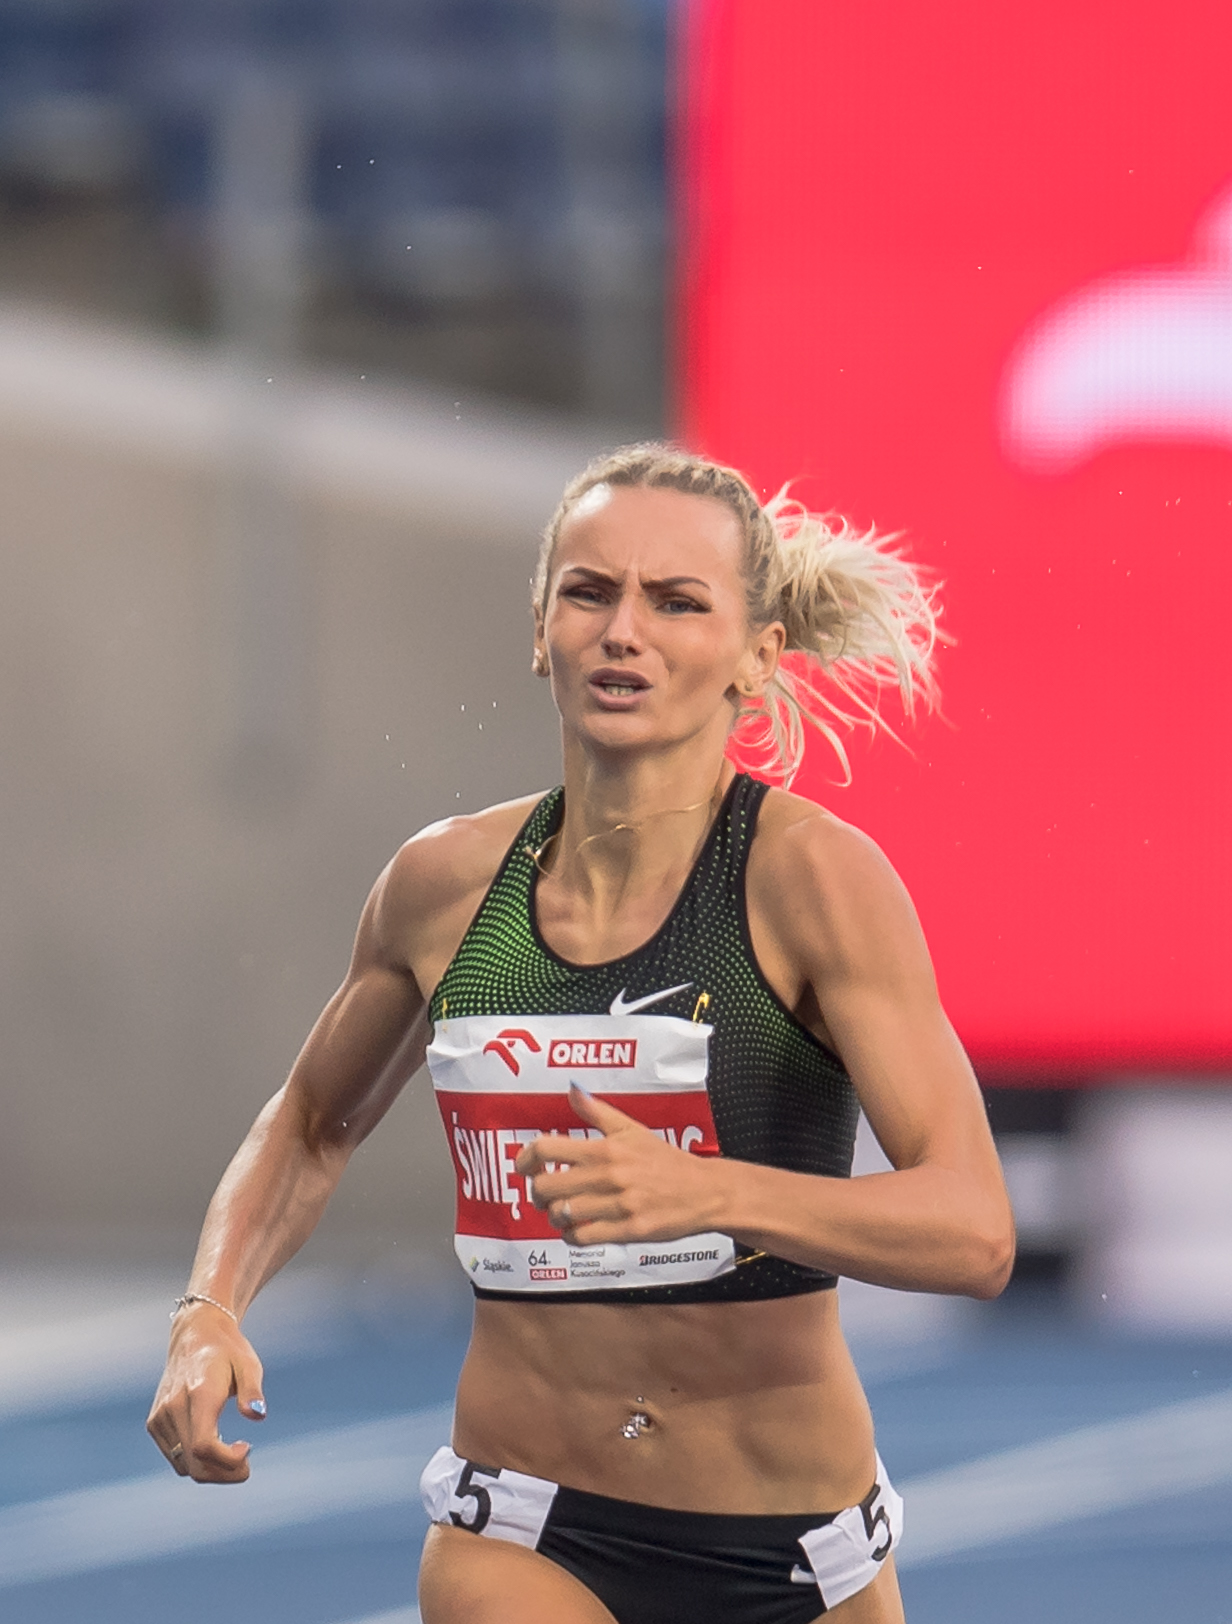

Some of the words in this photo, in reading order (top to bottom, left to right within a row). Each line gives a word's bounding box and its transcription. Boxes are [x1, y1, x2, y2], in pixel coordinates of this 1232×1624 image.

[551, 1041, 632, 1066] ORLEN
[638, 1250, 720, 1266] BRIDGESTONE
[531, 1269, 565, 1279] ORLEN
[448, 1461, 502, 1535] 5
[859, 1483, 894, 1562] 5
